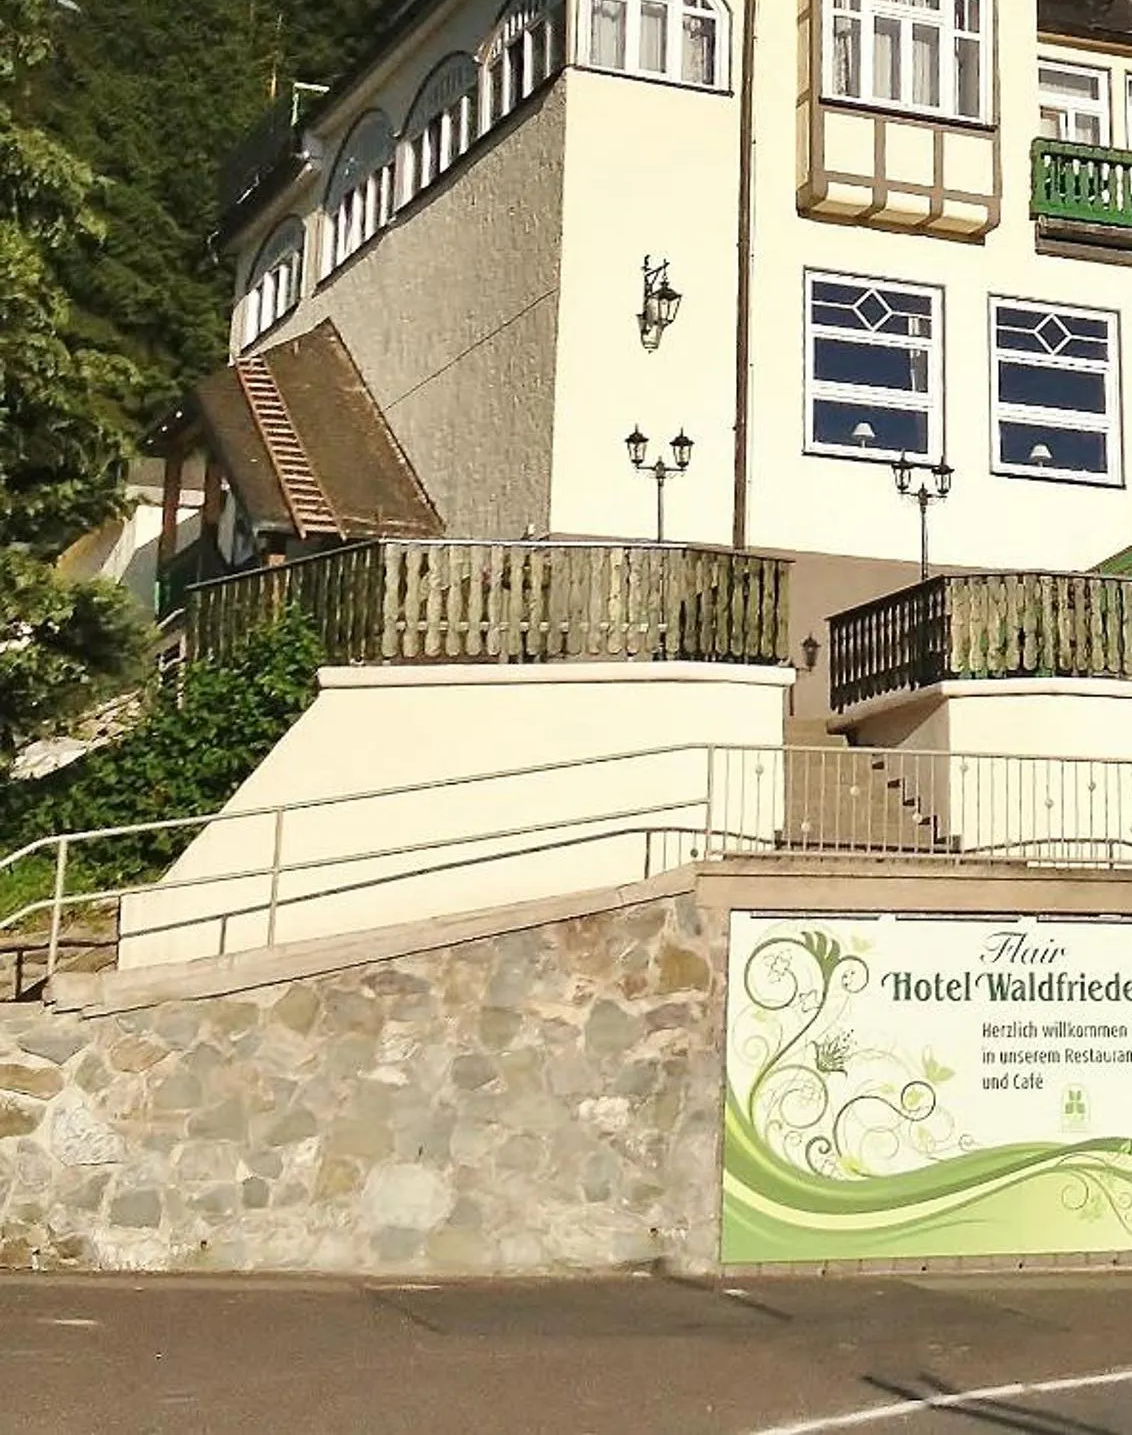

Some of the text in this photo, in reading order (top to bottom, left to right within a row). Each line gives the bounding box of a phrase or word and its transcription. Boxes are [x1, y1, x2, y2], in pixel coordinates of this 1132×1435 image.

[980, 931, 1068, 965] Flair
[881, 972, 971, 1002] Hotel
[982, 1021, 1128, 1039] Herzlich willkommen
[982, 1048, 995, 1064] in
[1000, 1048, 1060, 1064] unserem
[982, 1073, 1044, 1091] und Café
